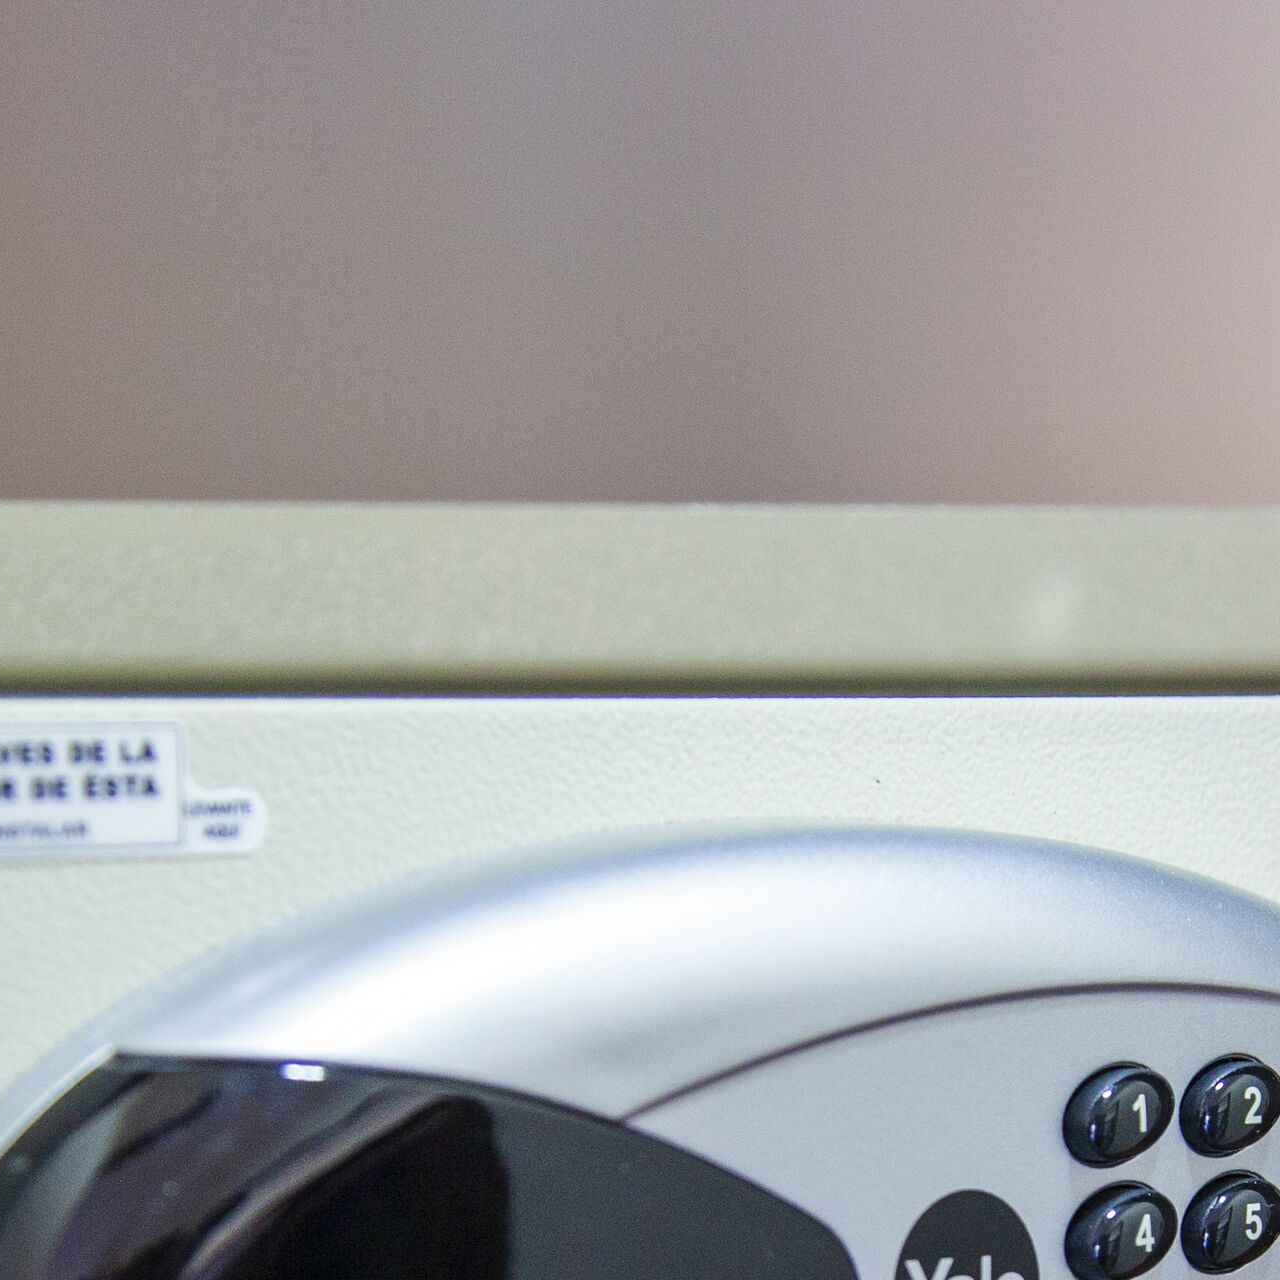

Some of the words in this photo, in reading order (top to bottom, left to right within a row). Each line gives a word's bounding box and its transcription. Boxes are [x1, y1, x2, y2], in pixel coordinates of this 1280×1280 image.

[70, 740, 106, 764] DE
[121, 738, 157, 762] LA
[31, 777, 68, 800] DE
[1132, 1093, 1147, 1133] 1
[1244, 1086, 1262, 1125] 2
[1135, 1213, 1155, 1254] 4
[1246, 1203, 1263, 1241] 5
